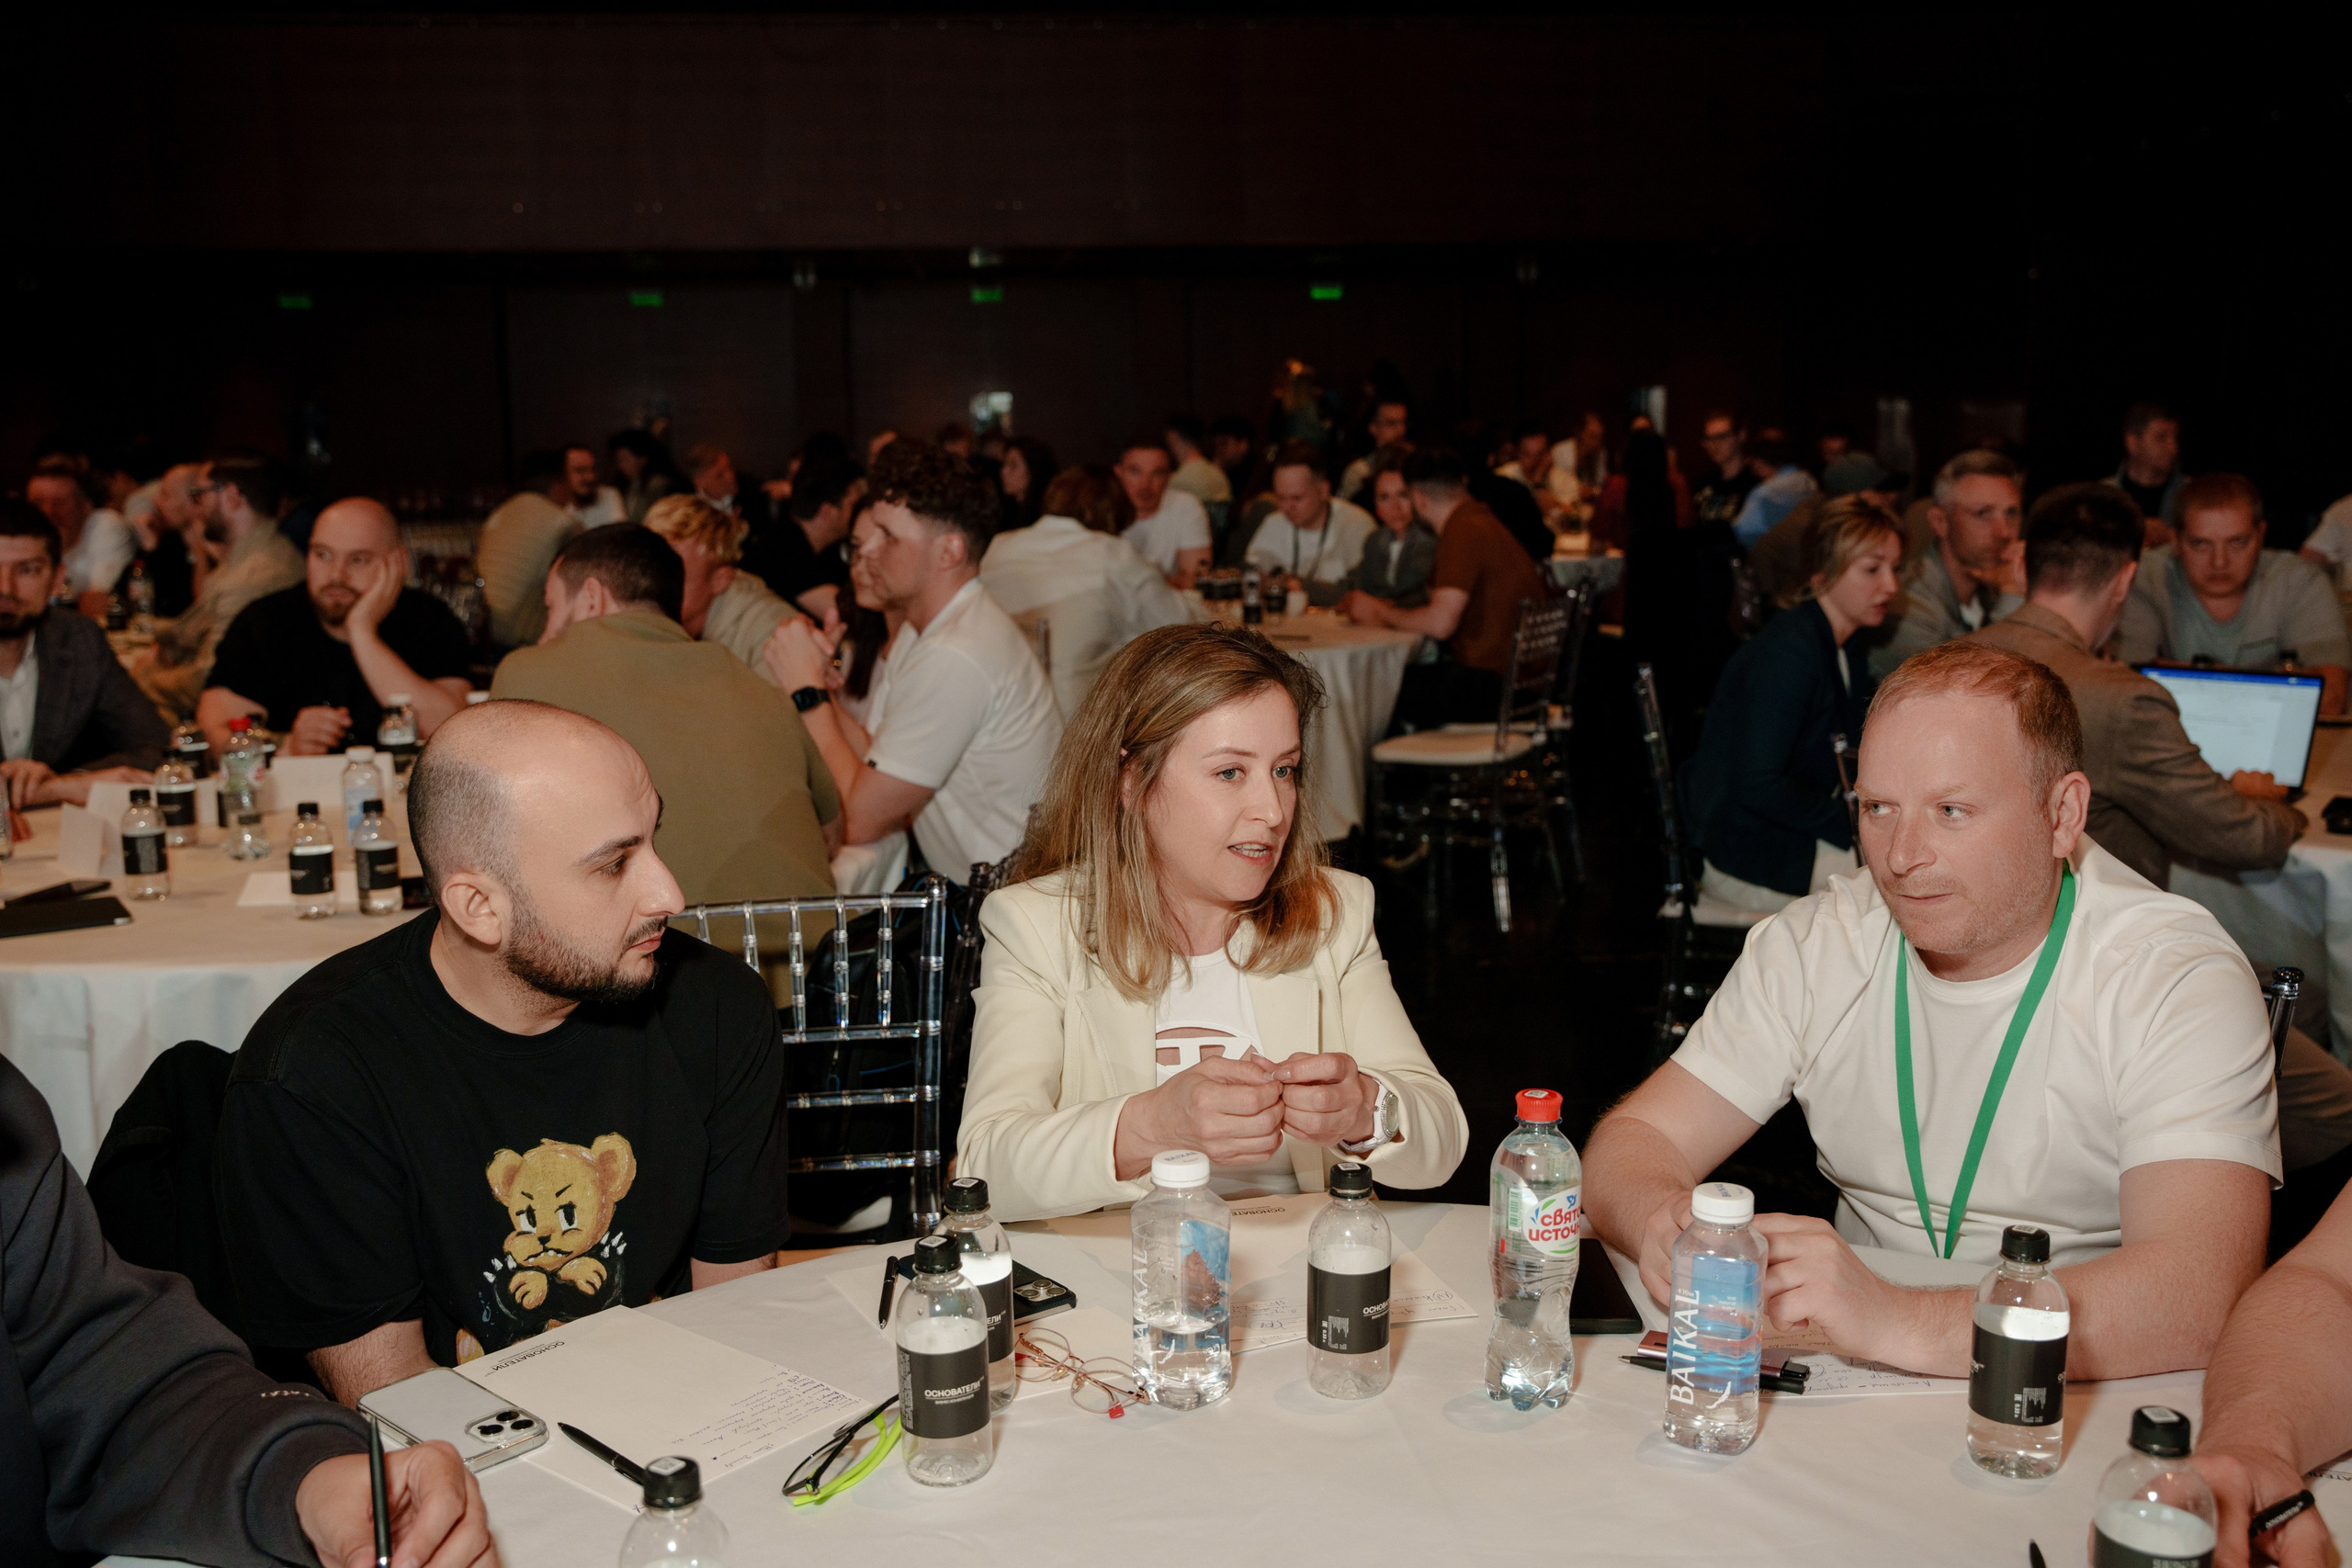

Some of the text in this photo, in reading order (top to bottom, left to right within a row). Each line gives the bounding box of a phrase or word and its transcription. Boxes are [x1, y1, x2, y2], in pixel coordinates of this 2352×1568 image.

[1231, 1207, 1285, 1216] ОСНОВАТЕ
[1363, 1300, 1389, 1314] ОСНОВ
[492, 1341, 565, 1371] ОСНОВАТЕЛИ
[1670, 1290, 1700, 1405] BAIKAL
[924, 1381, 980, 1398] ОСНОВАТЕЛИ
